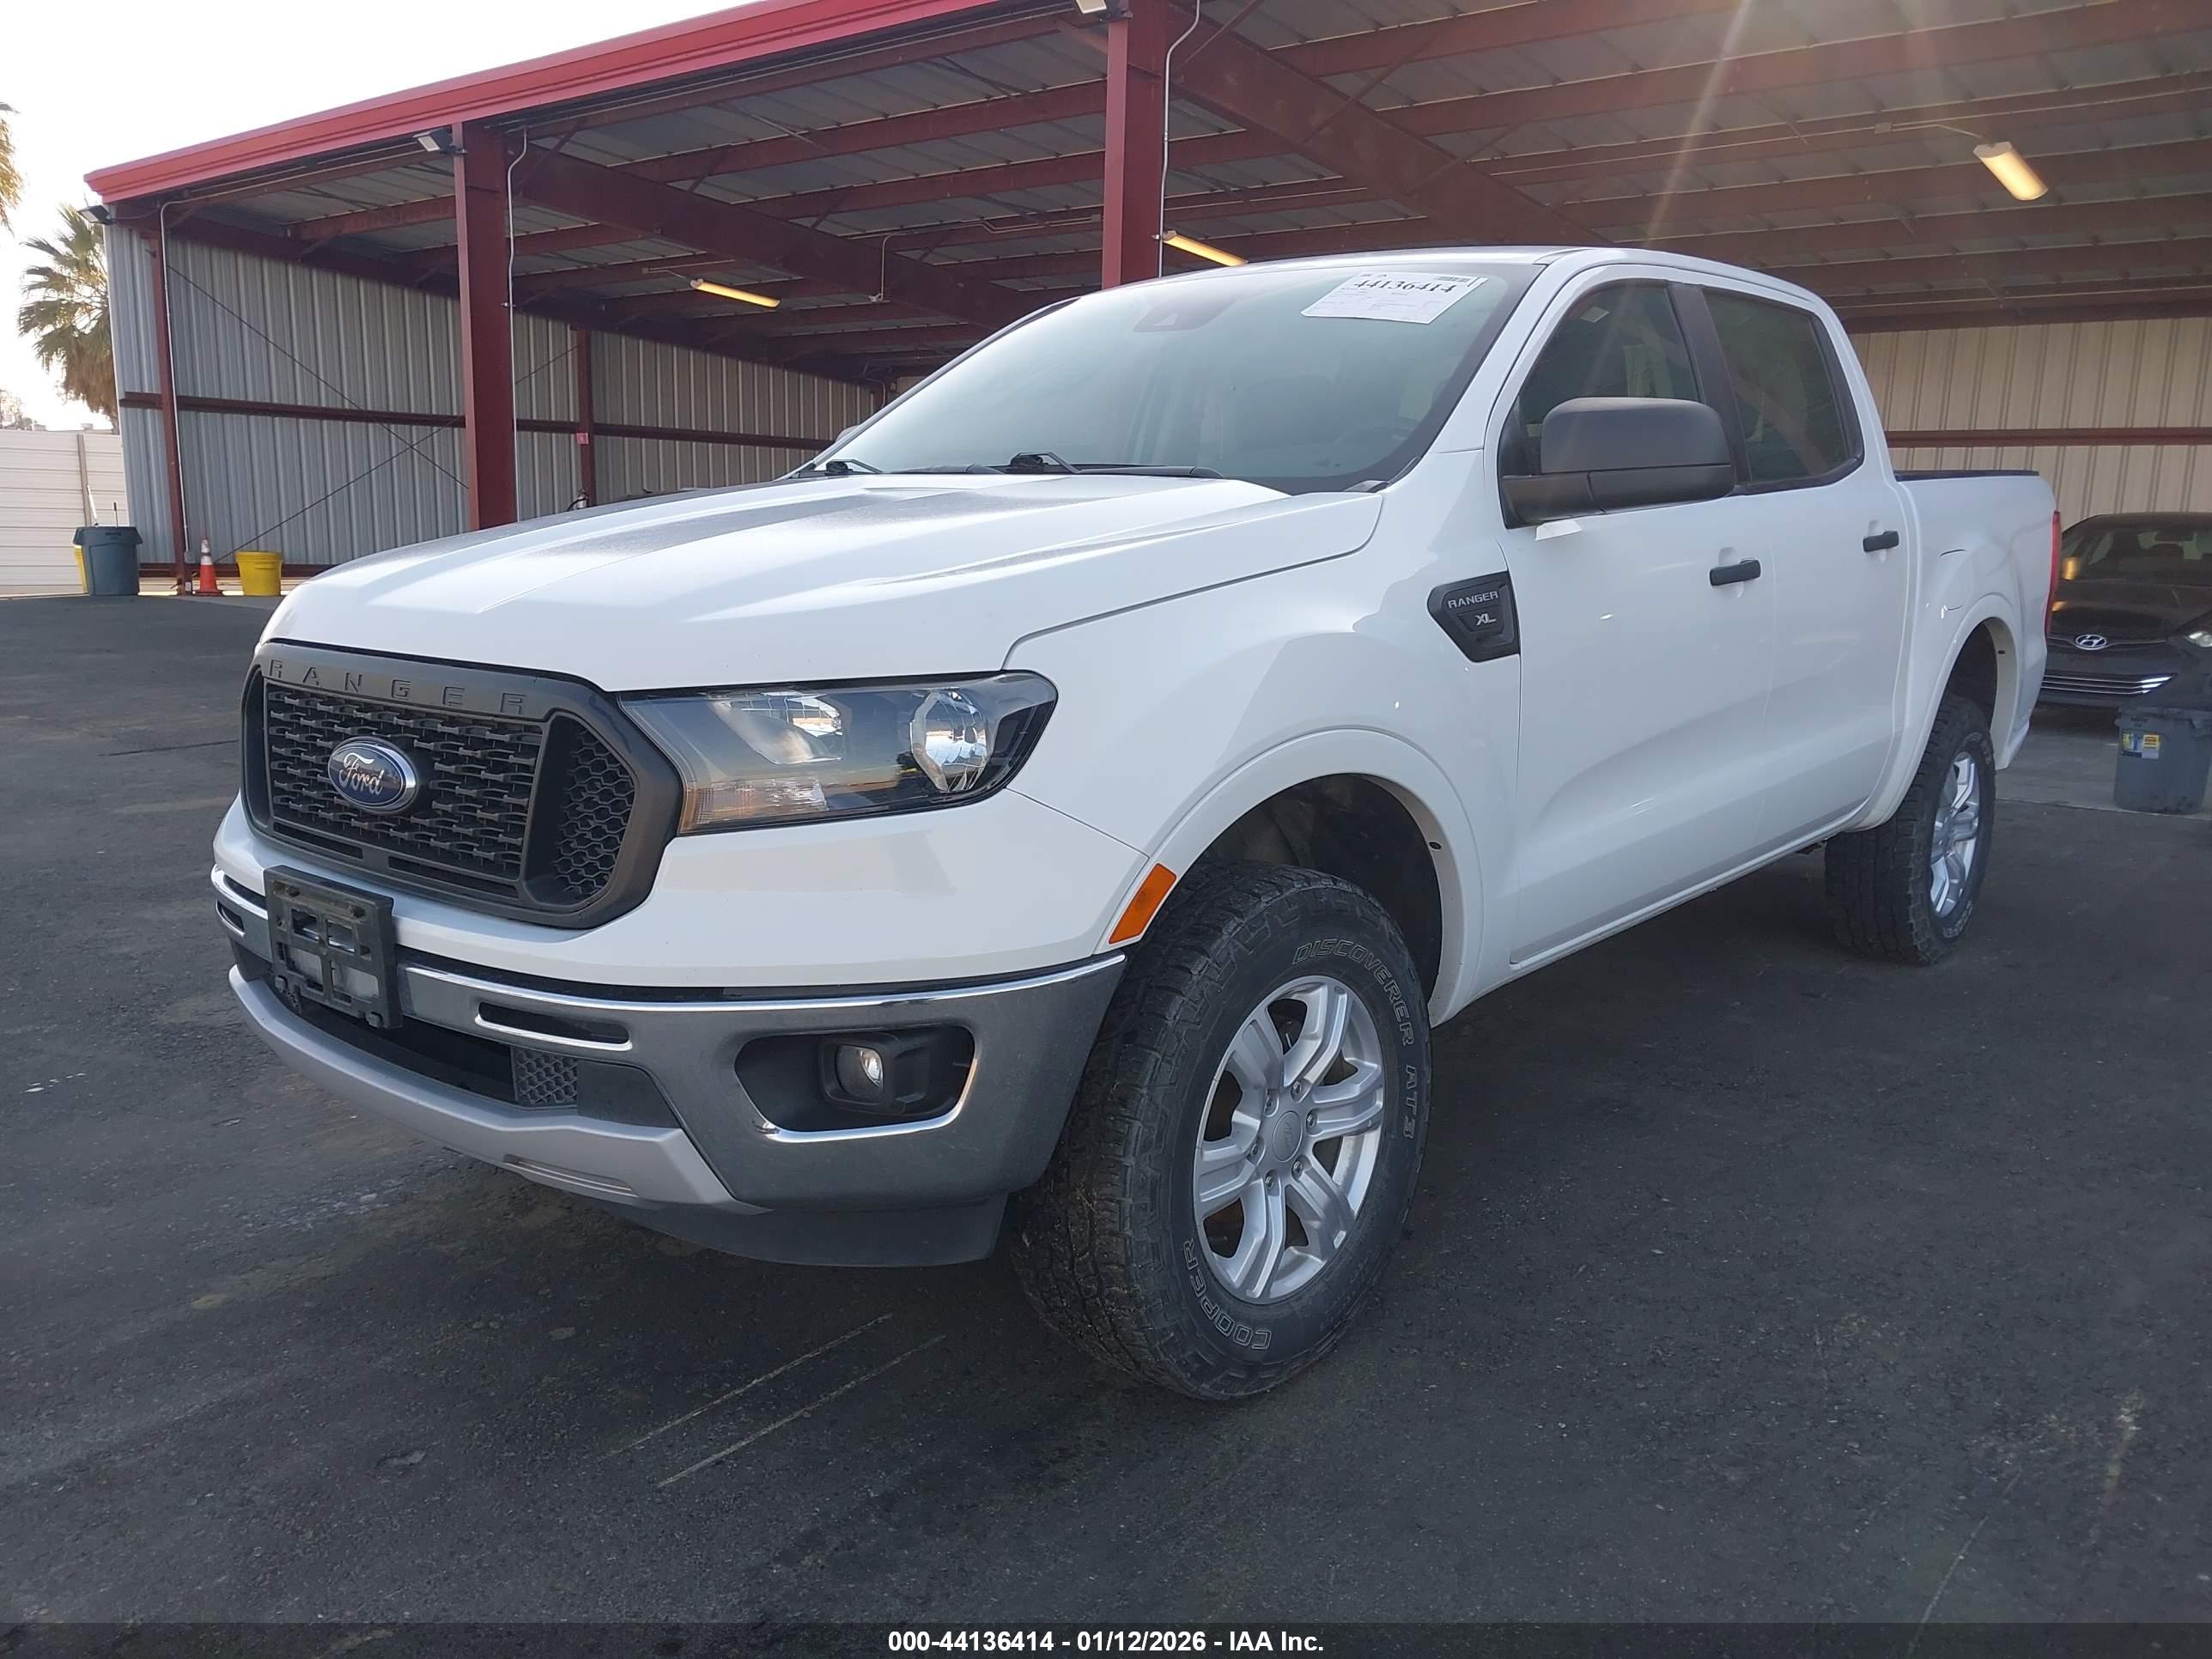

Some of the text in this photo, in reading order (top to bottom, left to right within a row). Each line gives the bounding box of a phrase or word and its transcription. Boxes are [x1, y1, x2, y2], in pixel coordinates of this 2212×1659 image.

[1354, 279, 1456, 293] 44136414
[1448, 591, 1498, 609] RANGER
[1475, 613, 1497, 626] XL
[268, 659, 526, 715] RANGER
[339, 751, 385, 796] Ford
[1291, 939, 1415, 1047] DISCOVERER
[1183, 1237, 1272, 1350] COOPER
